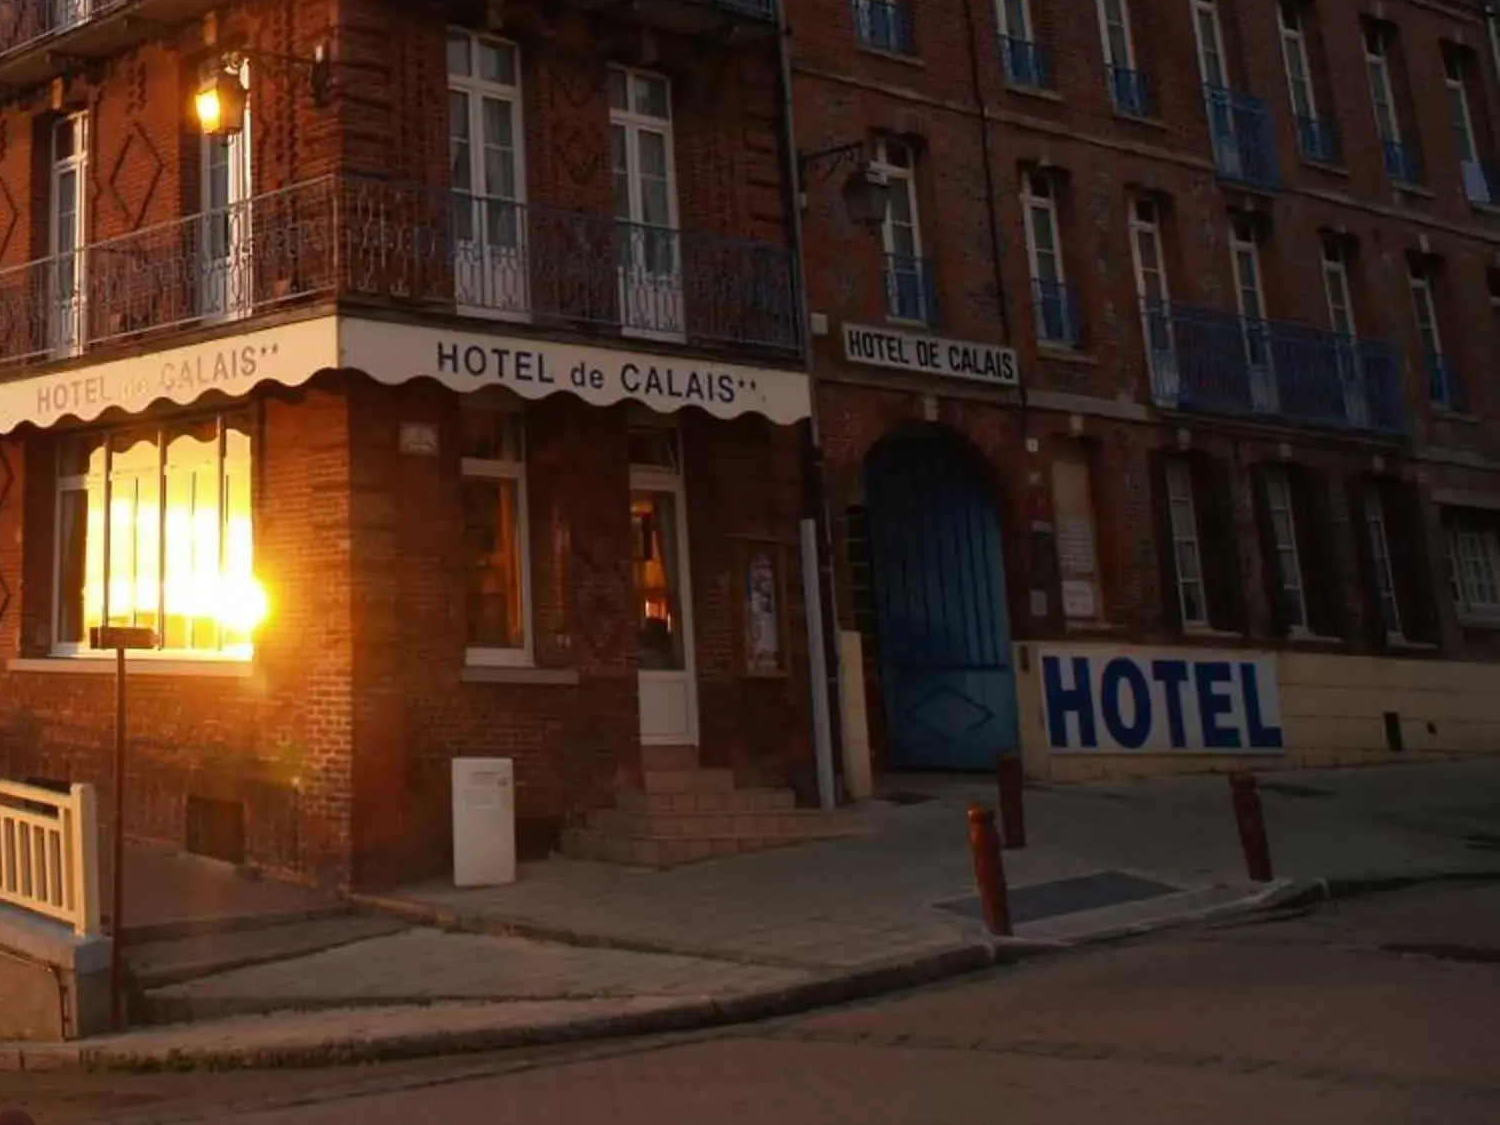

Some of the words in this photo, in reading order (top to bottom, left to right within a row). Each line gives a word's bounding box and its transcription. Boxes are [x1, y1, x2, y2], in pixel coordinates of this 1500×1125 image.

[436, 341, 554, 384] HOTEL
[570, 362, 604, 389] de
[849, 330, 909, 364] HOTEL
[916, 340, 941, 368] DE
[948, 346, 1013, 379] CALAIS
[37, 375, 112, 414] HOTEL
[1042, 656, 1283, 749] HOTEL
